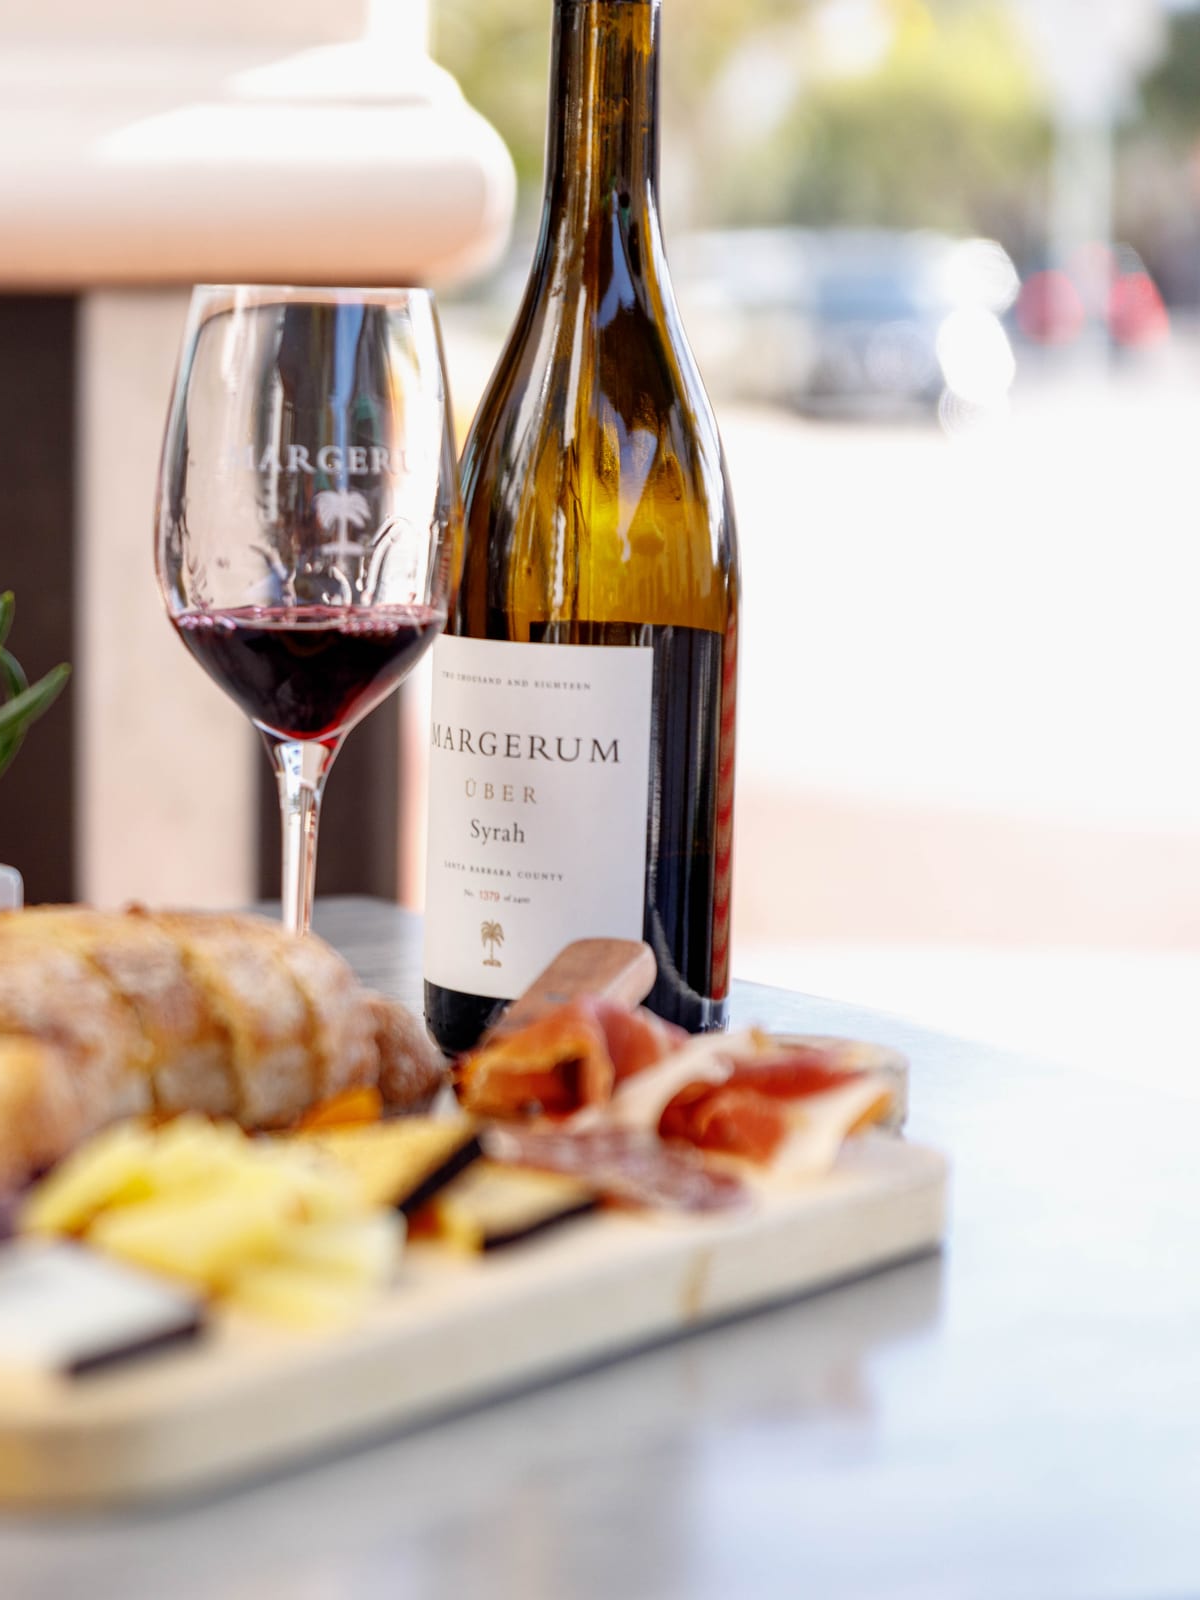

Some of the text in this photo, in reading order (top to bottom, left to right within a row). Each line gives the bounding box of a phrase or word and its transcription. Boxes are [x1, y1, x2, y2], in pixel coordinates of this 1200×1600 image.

[457, 672, 503, 686] THOUSAND
[507, 678, 530, 688] AND
[534, 679, 592, 691] EIGHTEEN
[431, 722, 622, 764] MARGERUM
[464, 779, 538, 805] ÜBER
[469, 819, 526, 846] Syrah
[469, 865, 512, 878] BARBARA
[517, 870, 565, 882] COUNTY
[479, 889, 501, 903] 1379
